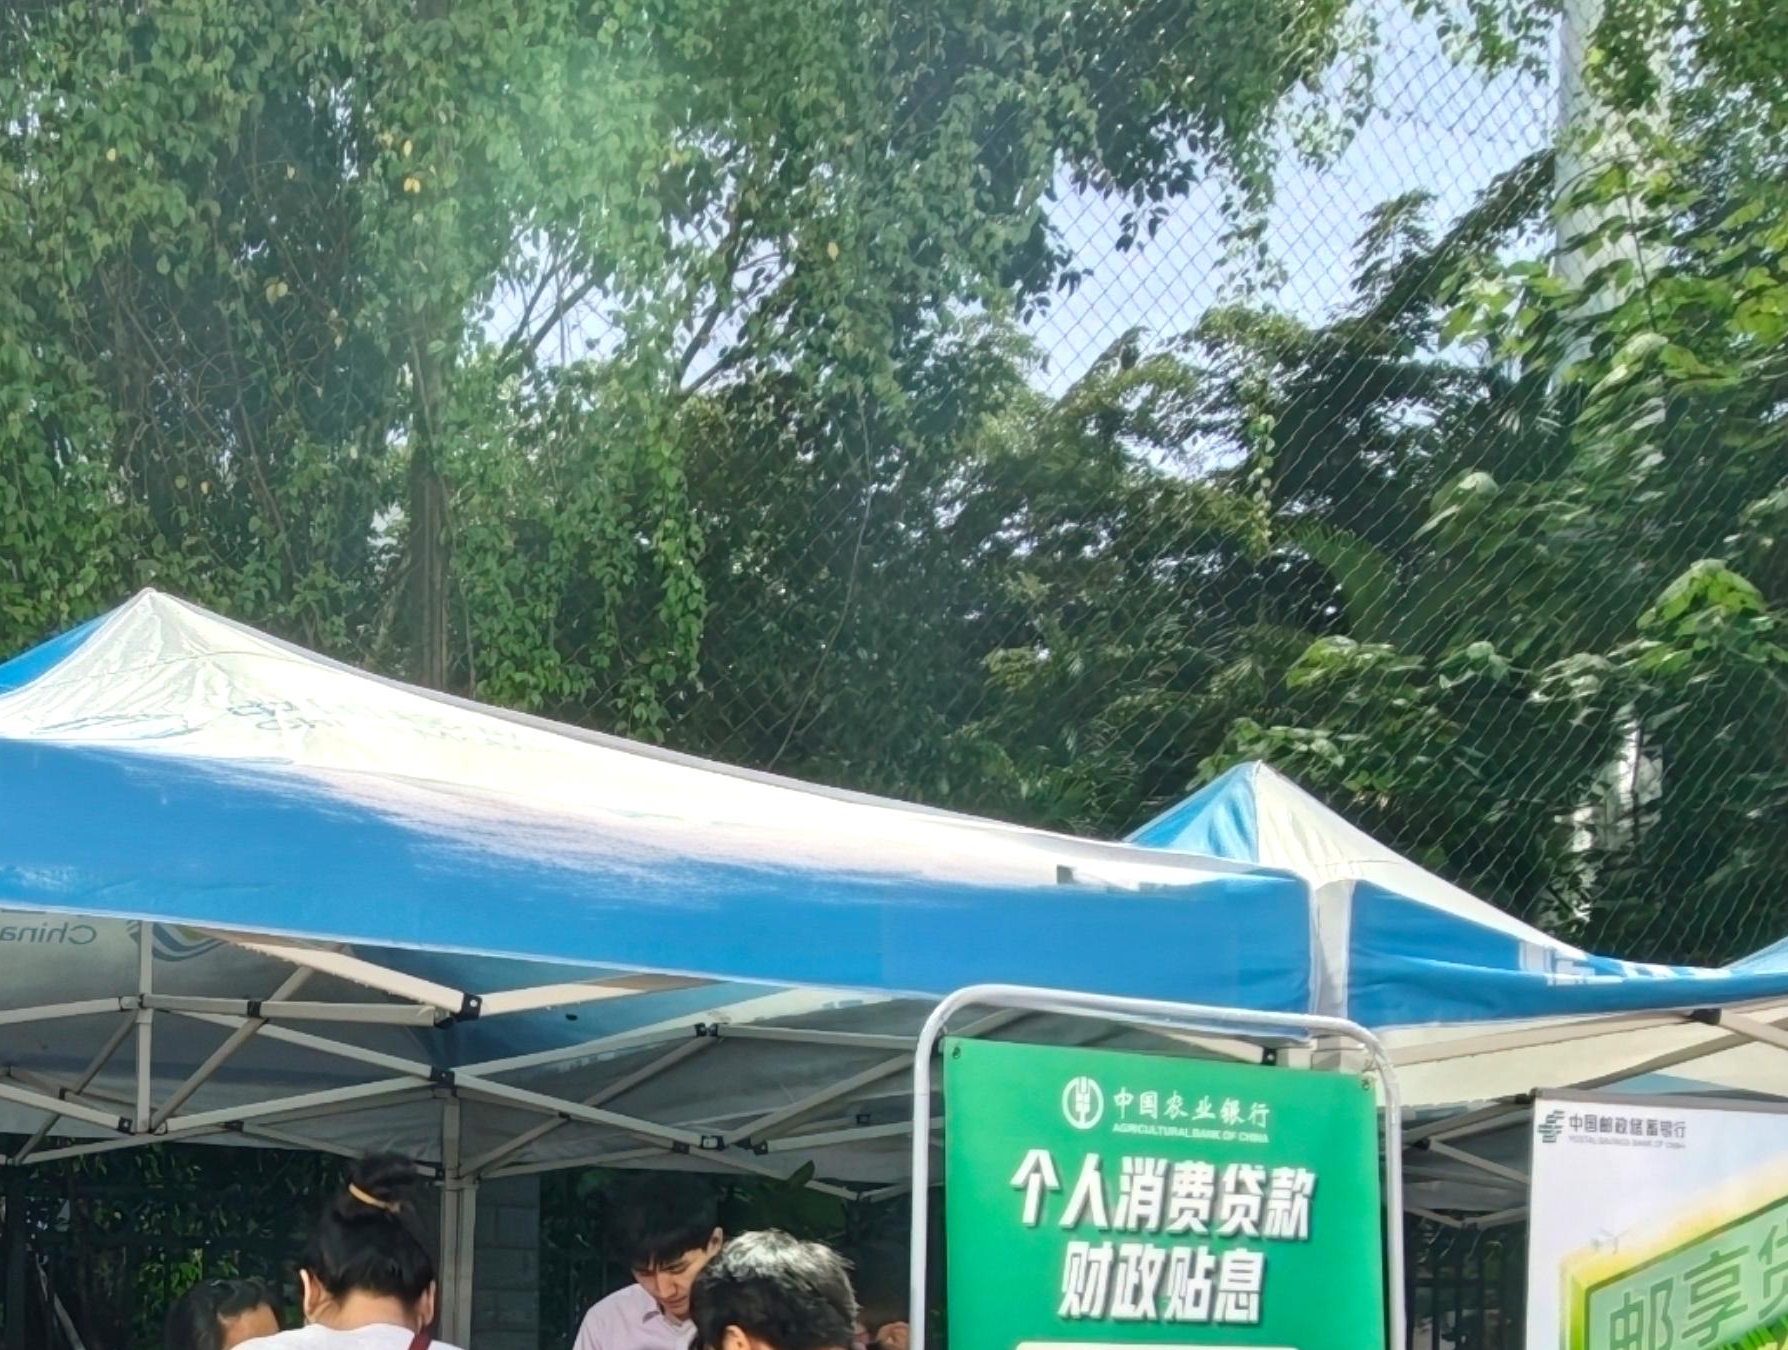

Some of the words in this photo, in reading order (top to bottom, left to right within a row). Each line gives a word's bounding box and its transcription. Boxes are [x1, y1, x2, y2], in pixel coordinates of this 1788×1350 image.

[1114, 1086, 1271, 1129] 中国农业银行
[1010, 1149, 1317, 1239] 个人消费贷款
[1057, 1241, 1267, 1324] 财政贴息
